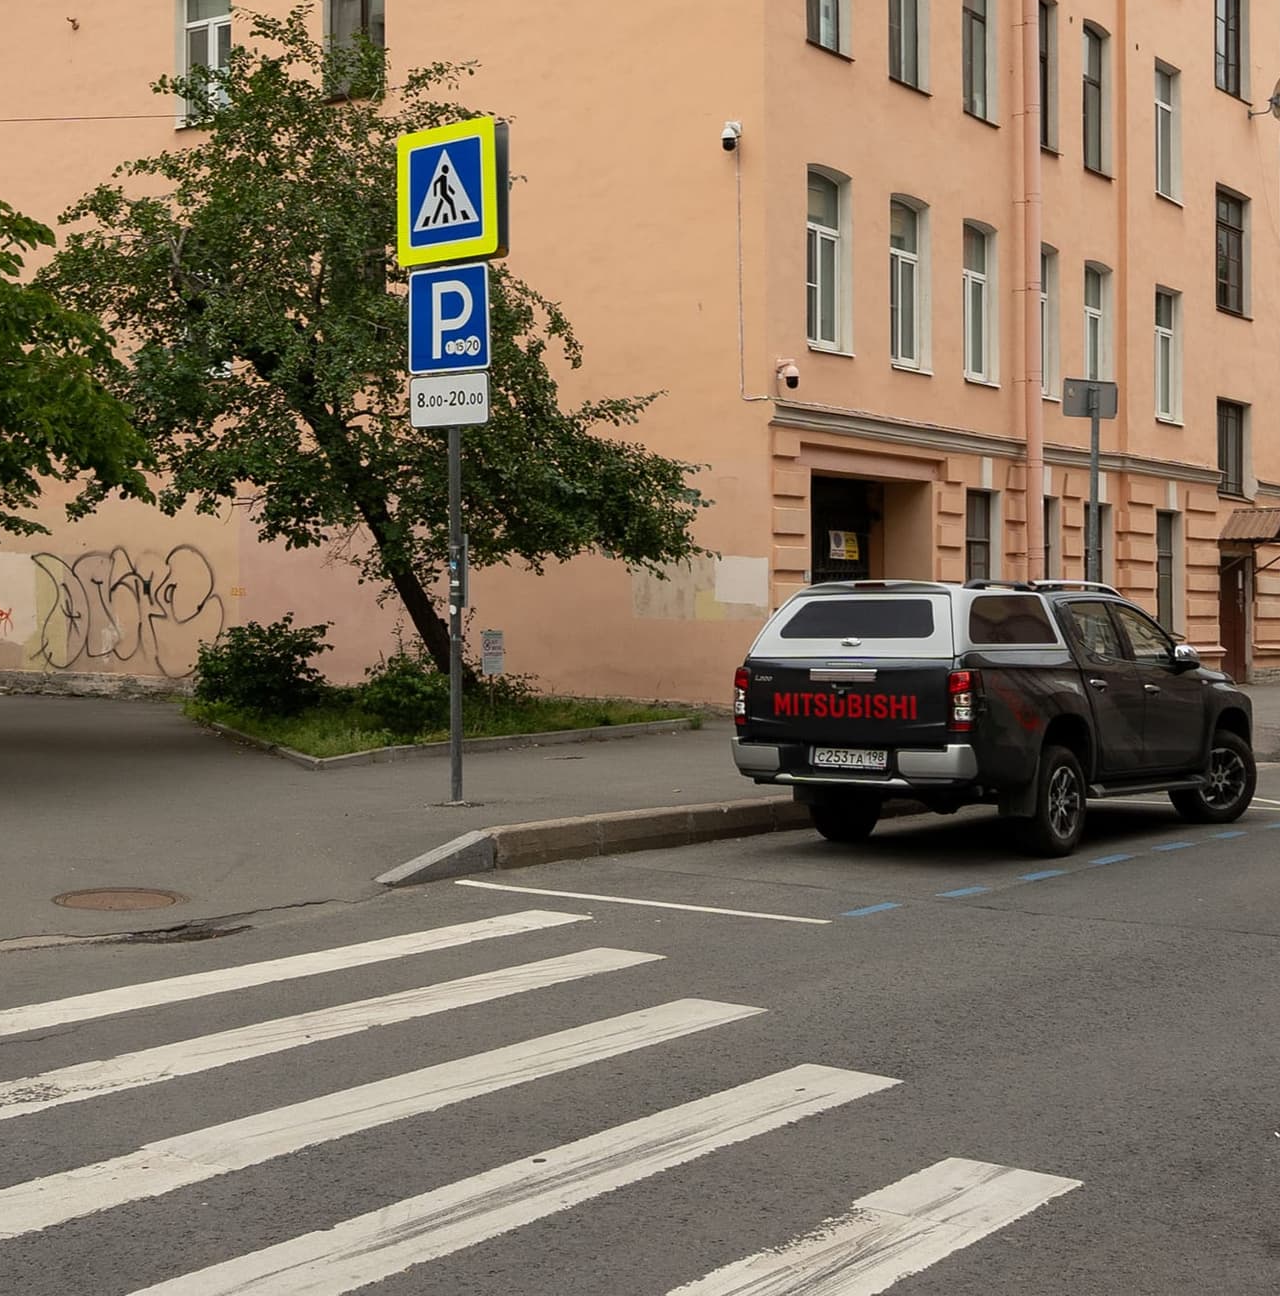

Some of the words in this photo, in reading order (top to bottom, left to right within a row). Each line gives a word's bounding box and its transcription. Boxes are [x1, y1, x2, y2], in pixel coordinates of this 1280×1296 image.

[432, 280, 473, 359] P
[466, 339, 480, 352] 20
[417, 390, 484, 408] 8.00-20.00
[773, 692, 917, 720] MITSUBISHI
